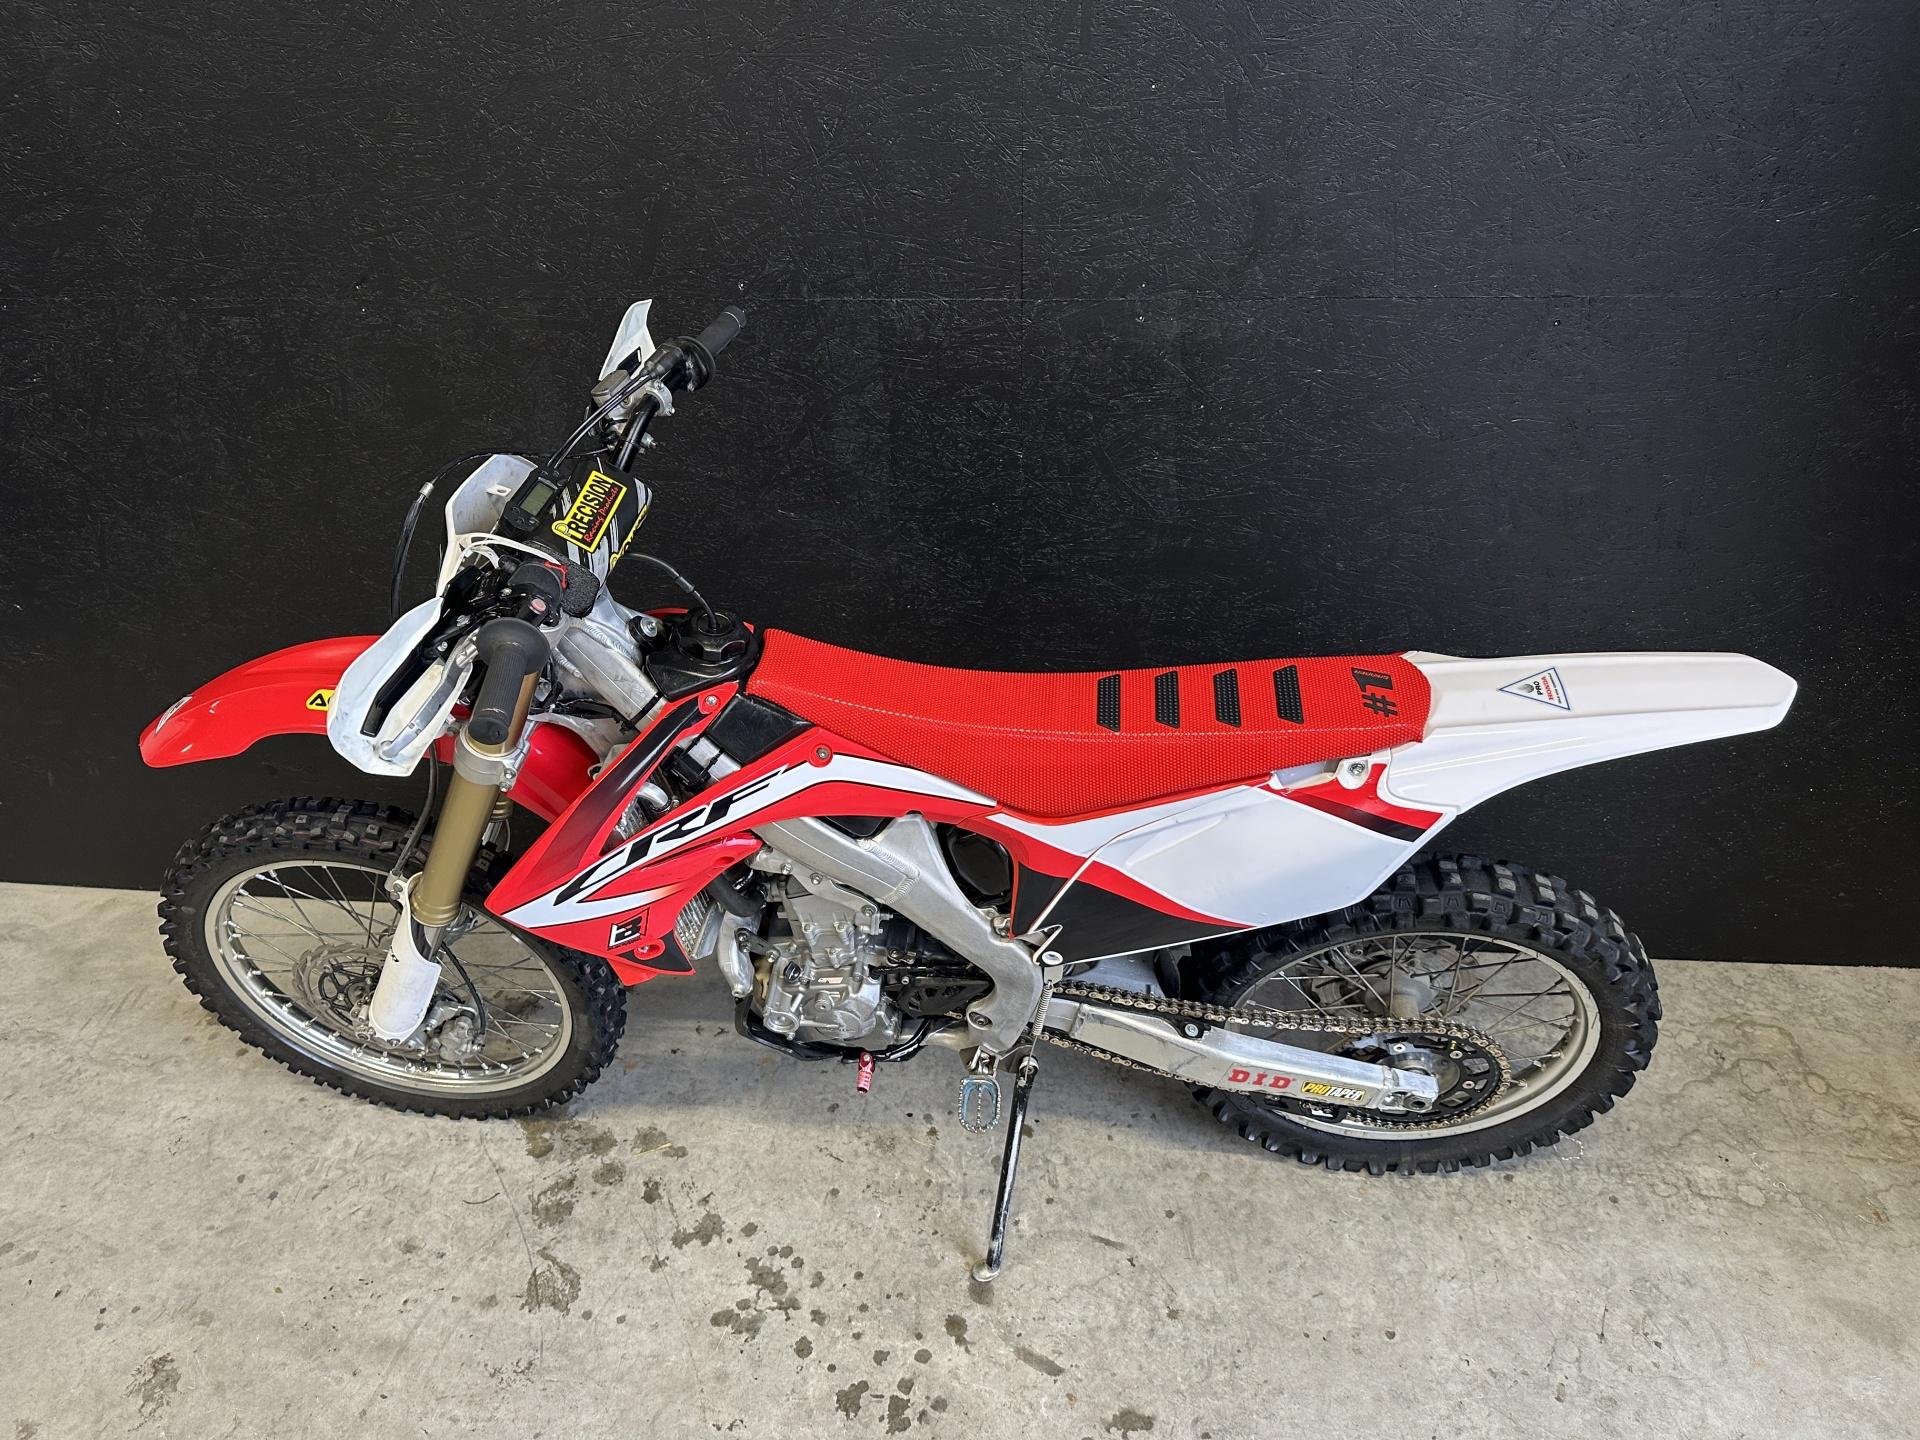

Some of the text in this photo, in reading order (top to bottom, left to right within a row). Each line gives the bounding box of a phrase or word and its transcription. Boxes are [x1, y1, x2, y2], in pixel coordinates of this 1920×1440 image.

[555, 474, 612, 541] PRECISION
[583, 486, 619, 542] Racing Products
[1351, 667, 1398, 717] #1
[1533, 681, 1543, 696] PRO
[1541, 676, 1554, 701] HONDA
[553, 768, 782, 906] CRF
